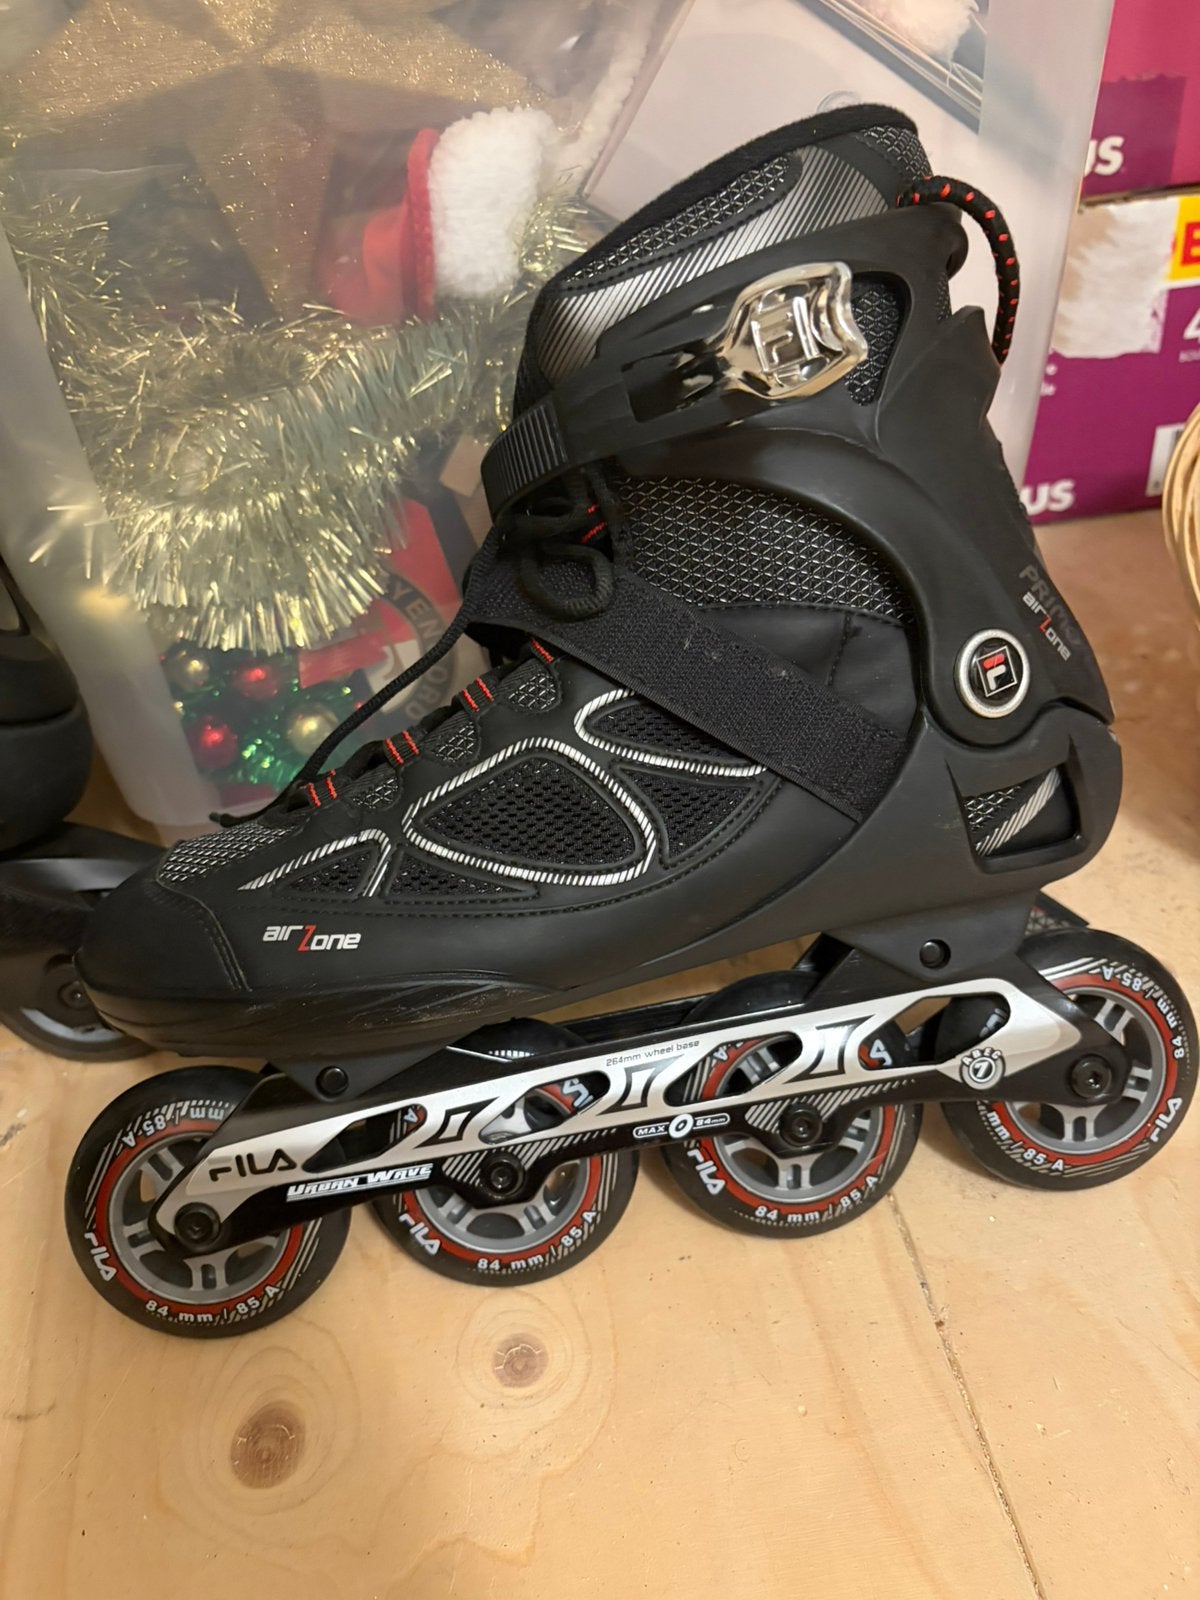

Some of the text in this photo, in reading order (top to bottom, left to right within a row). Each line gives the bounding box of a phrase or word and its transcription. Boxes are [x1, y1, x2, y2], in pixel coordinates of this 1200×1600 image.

[1102, 965, 1114, 980] A
[1121, 972, 1143, 992] 85
[1156, 997, 1178, 1029] mm
[605, 1040, 700, 1067] 264mm wheel base
[961, 1046, 1001, 1065] ABEC
[1172, 1035, 1185, 1059] 84
[974, 1061, 990, 1078] 7
[142, 1115, 167, 1136] 85
[637, 1125, 666, 1137] MAX
[1150, 1096, 1183, 1142] FILA
[121, 1130, 137, 1147] A
[986, 1111, 1011, 1140] mm
[1023, 1148, 1047, 1165] 85
[1051, 1159, 1065, 1171] A
[208, 1148, 298, 1182] FILA
[686, 1149, 727, 1195] FILA
[755, 1205, 778, 1221] 84
[787, 1211, 820, 1223] mm
[840, 1189, 862, 1208] 85
[865, 1175, 879, 1188] A
[398, 1213, 442, 1256] FILA
[477, 1258, 500, 1270] 84
[511, 1254, 544, 1270] mm
[560, 1226, 583, 1247] 85
[582, 1210, 598, 1224] A
[84, 1232, 117, 1281] FILA
[146, 1300, 169, 1316] 84
[178, 1312, 213, 1322] mm
[236, 1296, 260, 1314] 85
[265, 1284, 280, 1298] A
